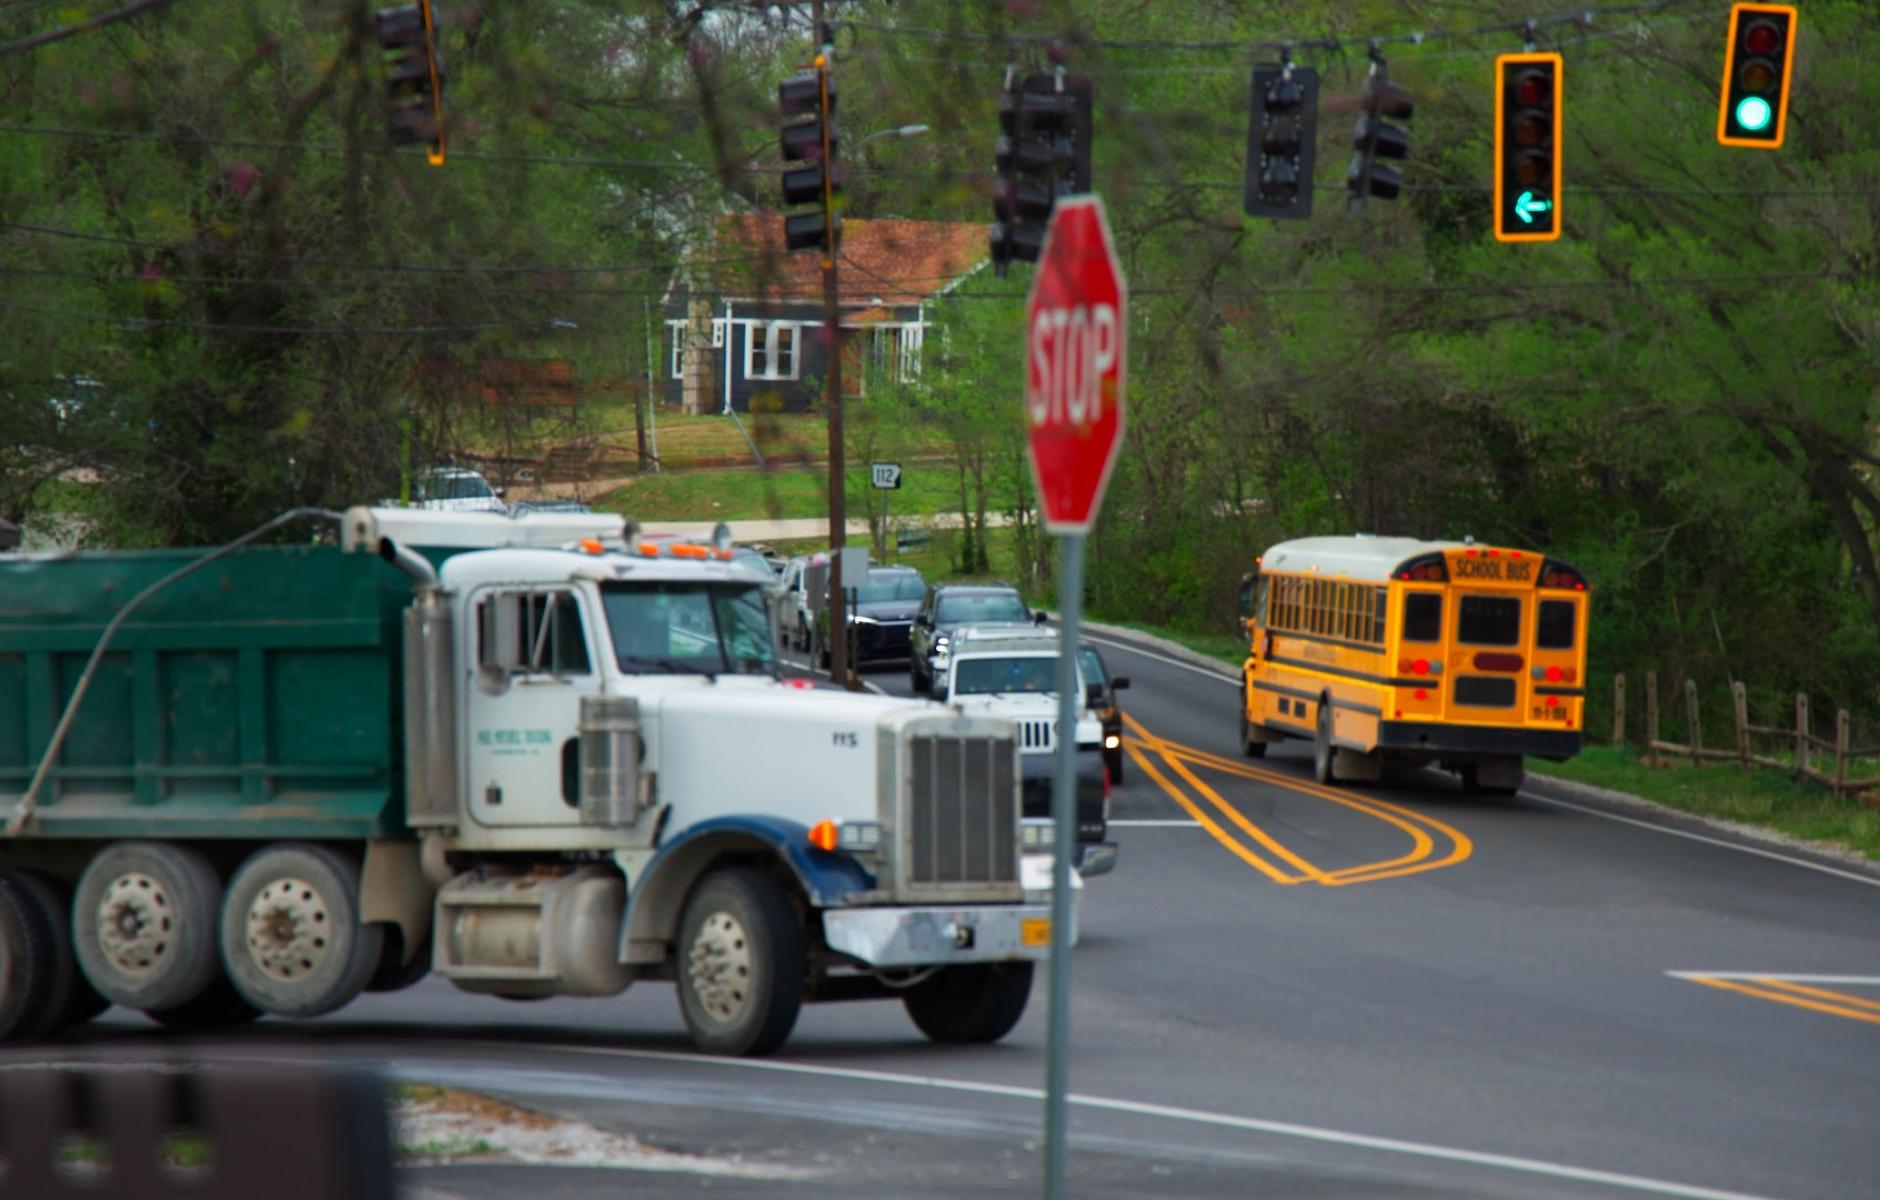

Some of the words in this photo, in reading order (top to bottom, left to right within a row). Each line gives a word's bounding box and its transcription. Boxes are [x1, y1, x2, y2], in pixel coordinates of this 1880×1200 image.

[1030, 303, 1115, 425] STOP
[876, 468, 895, 483] 112
[1456, 558, 1502, 579] SCHOOL
[1506, 561, 1531, 581] BUS
